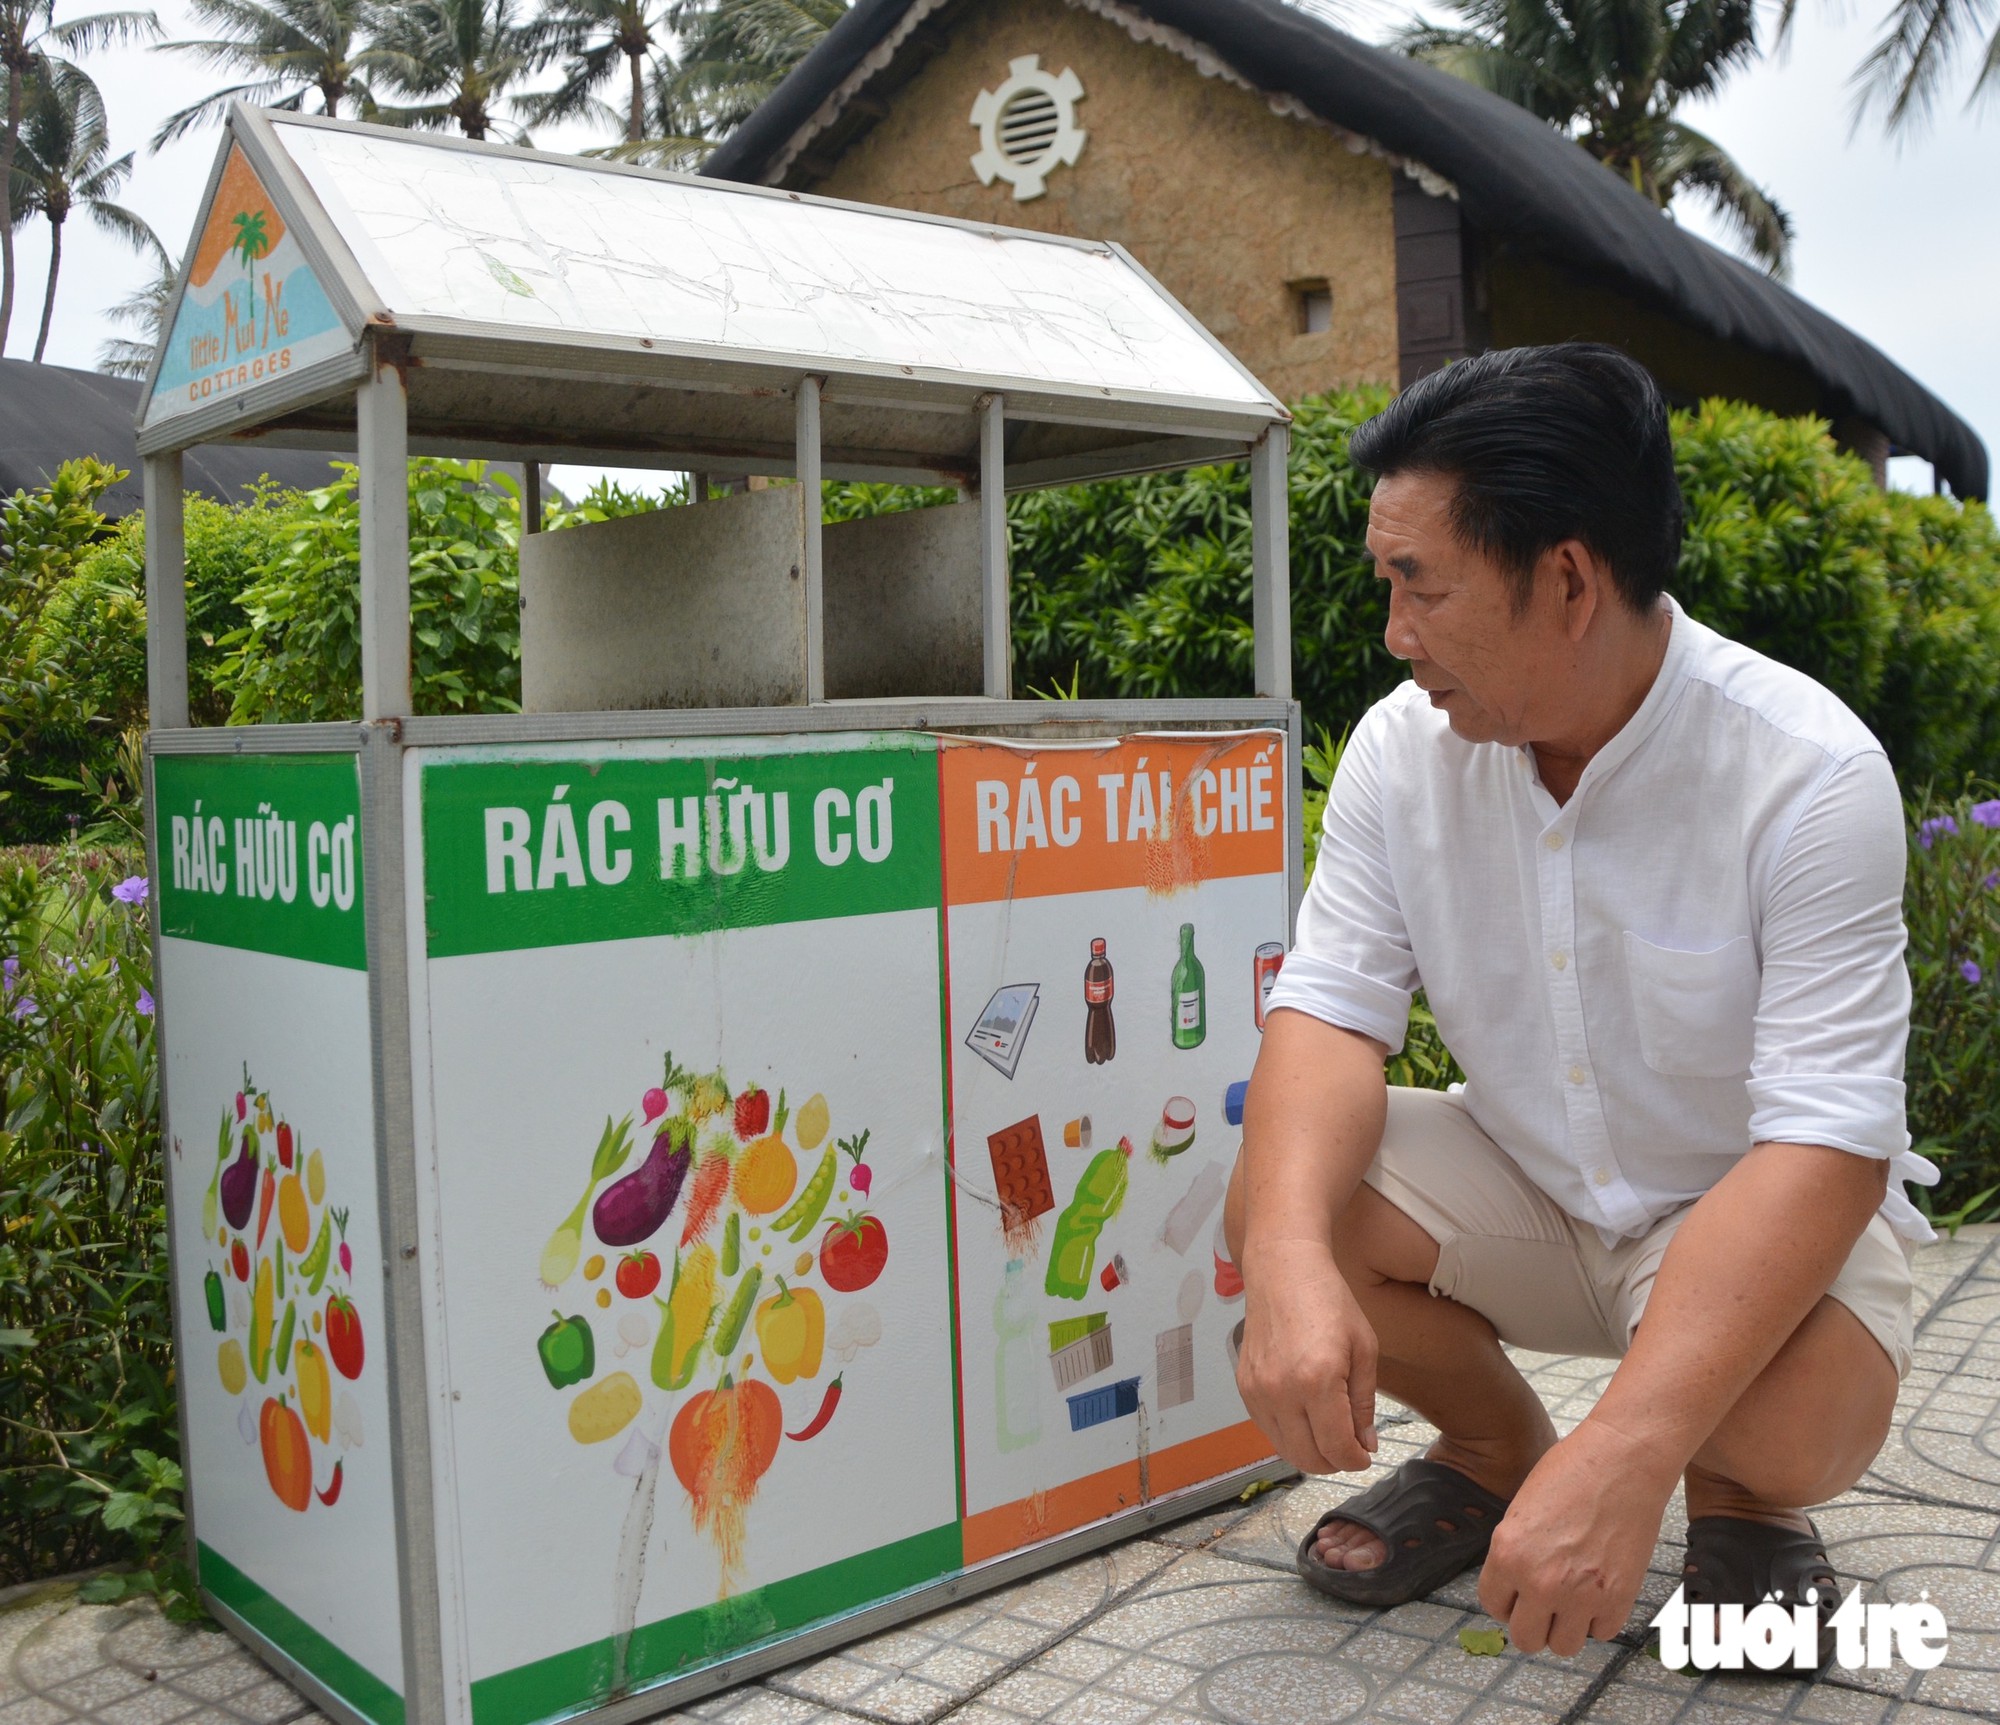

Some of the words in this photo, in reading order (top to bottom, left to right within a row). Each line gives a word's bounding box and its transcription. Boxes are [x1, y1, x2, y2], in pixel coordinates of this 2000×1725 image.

[189, 330, 220, 371] little
[261, 271, 289, 350] Ne
[189, 347, 291, 402] COTTAGES
[484, 784, 633, 894] RÁC
[657, 777, 791, 880] HỮU
[813, 777, 895, 867] CƠ
[975, 761, 1082, 854] RÁC
[1097, 756, 1173, 843] TÁI
[1191, 743, 1276, 837] CHẾ
[171, 799, 228, 896] RÁC
[234, 801, 298, 904] HỮU
[307, 814, 356, 912] CƠ
